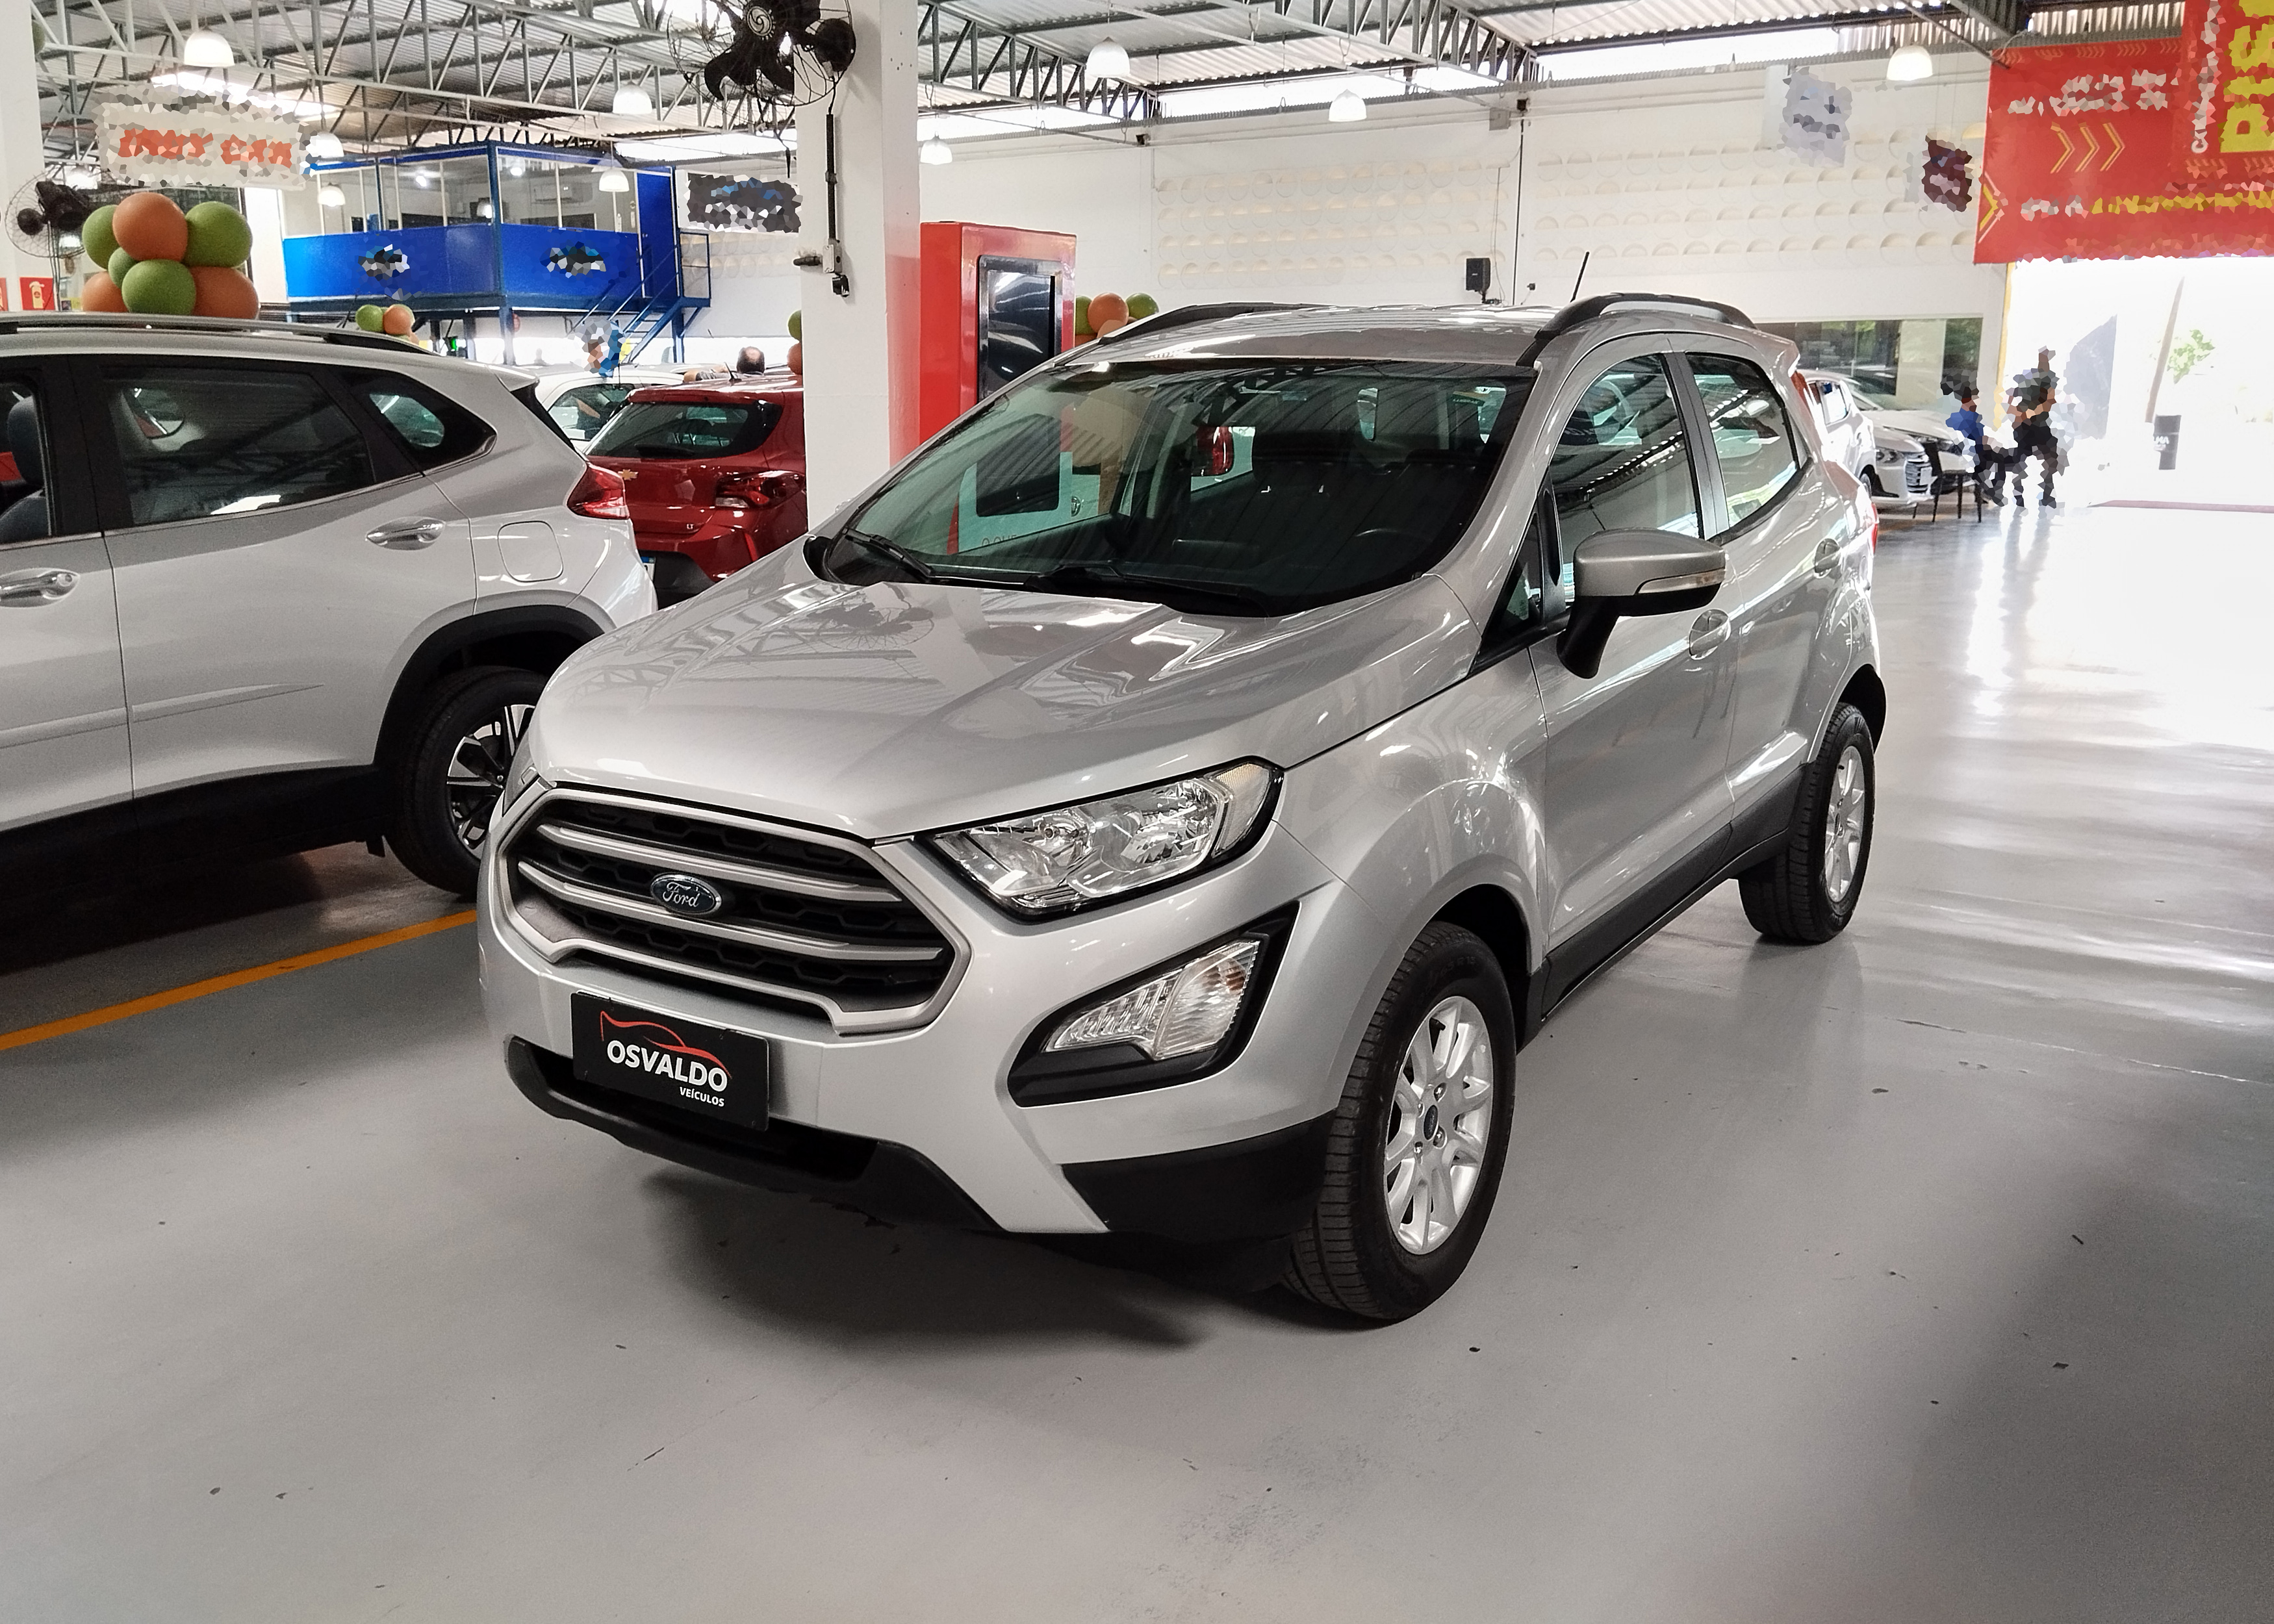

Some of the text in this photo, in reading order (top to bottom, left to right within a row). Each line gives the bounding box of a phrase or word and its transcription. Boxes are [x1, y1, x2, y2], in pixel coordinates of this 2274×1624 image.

[663, 882, 700, 907] Ford
[607, 1040, 728, 1092] OSVALDO
[680, 1086, 724, 1107] VEÍCULOS
